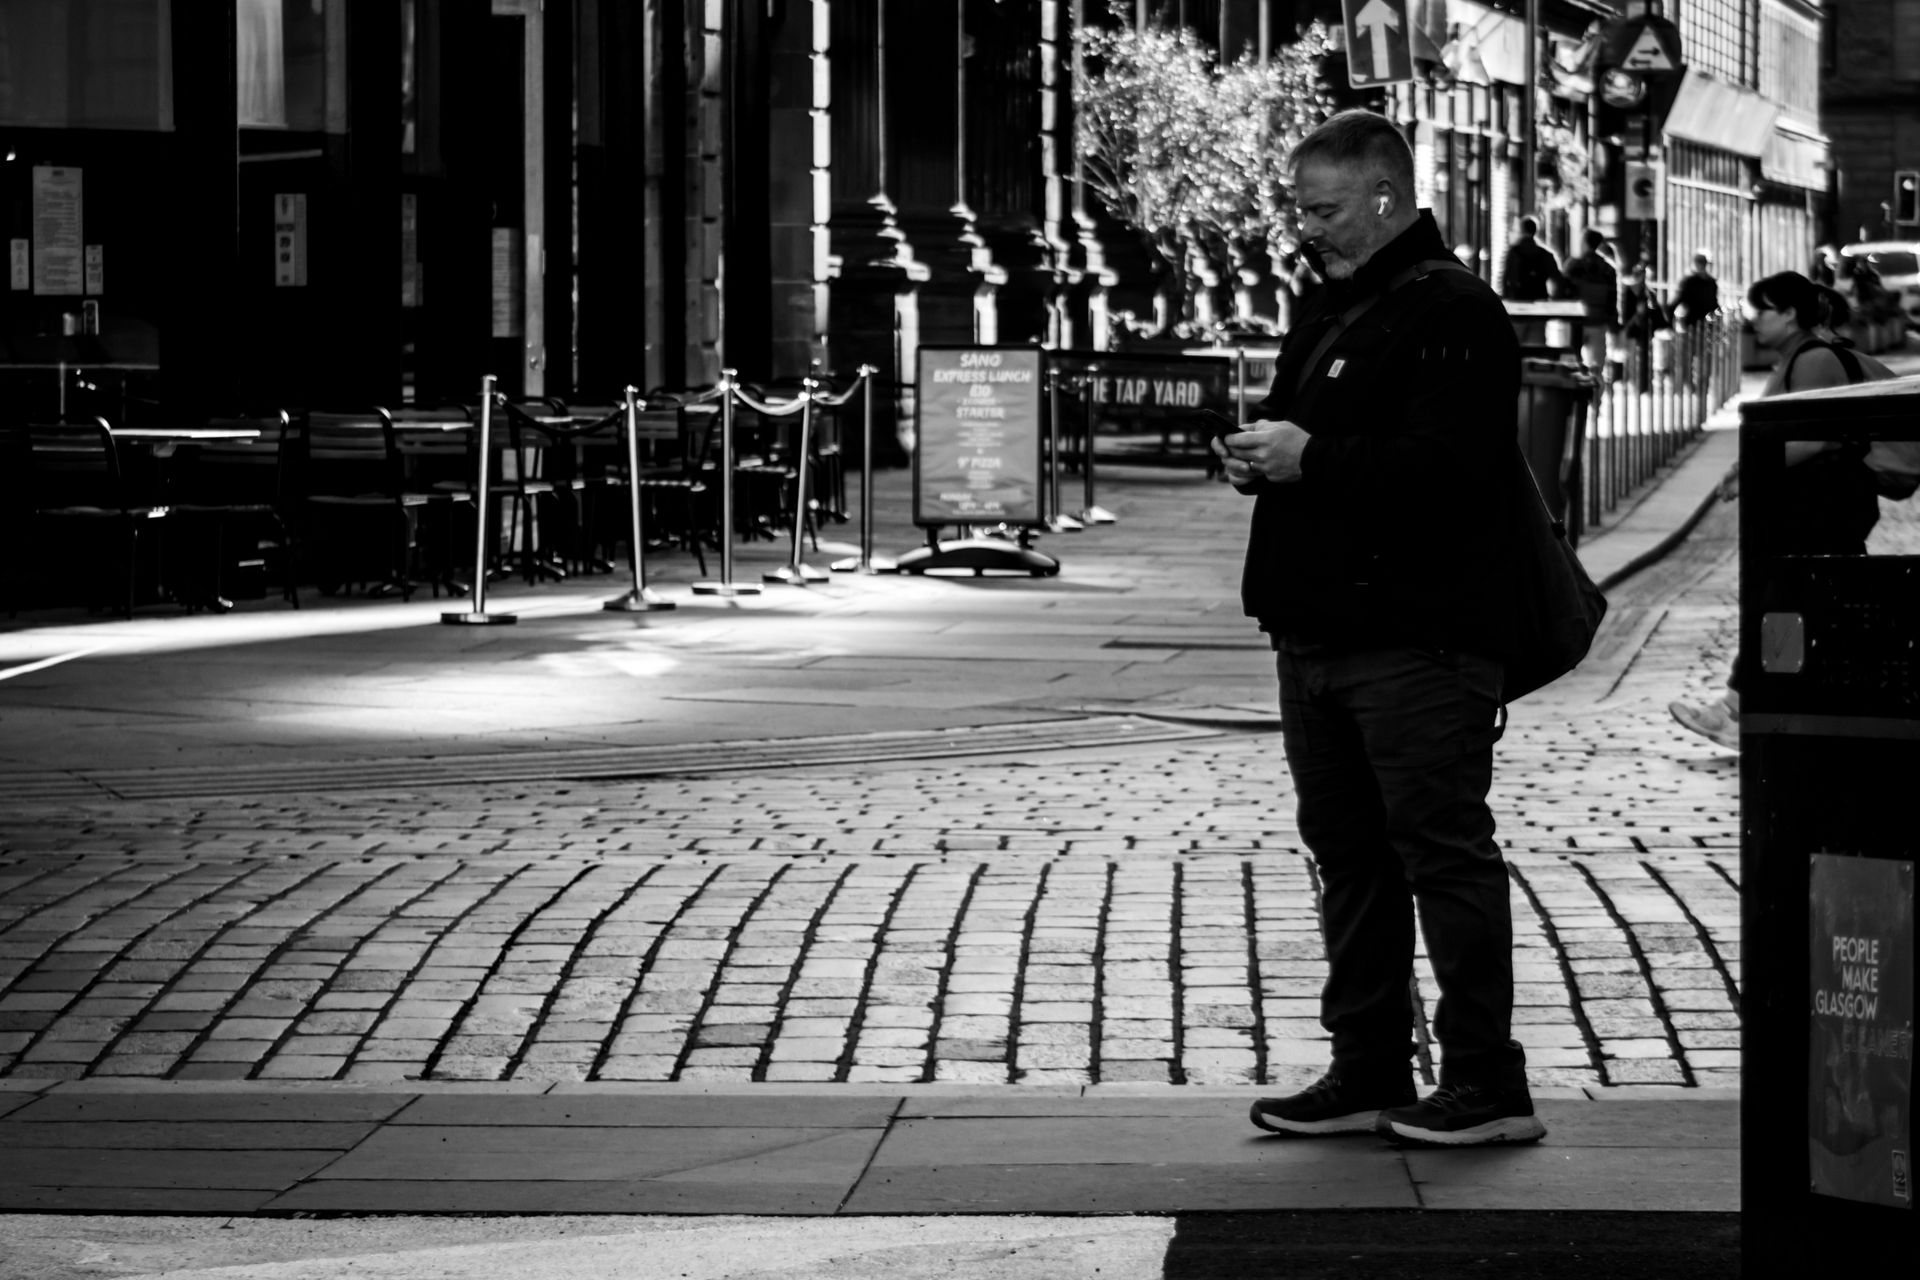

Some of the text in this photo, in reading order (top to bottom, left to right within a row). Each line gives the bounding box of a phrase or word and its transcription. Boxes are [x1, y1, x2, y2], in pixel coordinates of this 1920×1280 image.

[933, 369, 1031, 383] EXPRESS LUNCH
[1115, 378, 1147, 404] TAP
[1153, 380, 1201, 407] YARD
[1832, 935, 1879, 965] PEOPLE
[1841, 965, 1879, 993] MAKE
[1815, 989, 1879, 1020] GLASGOW
